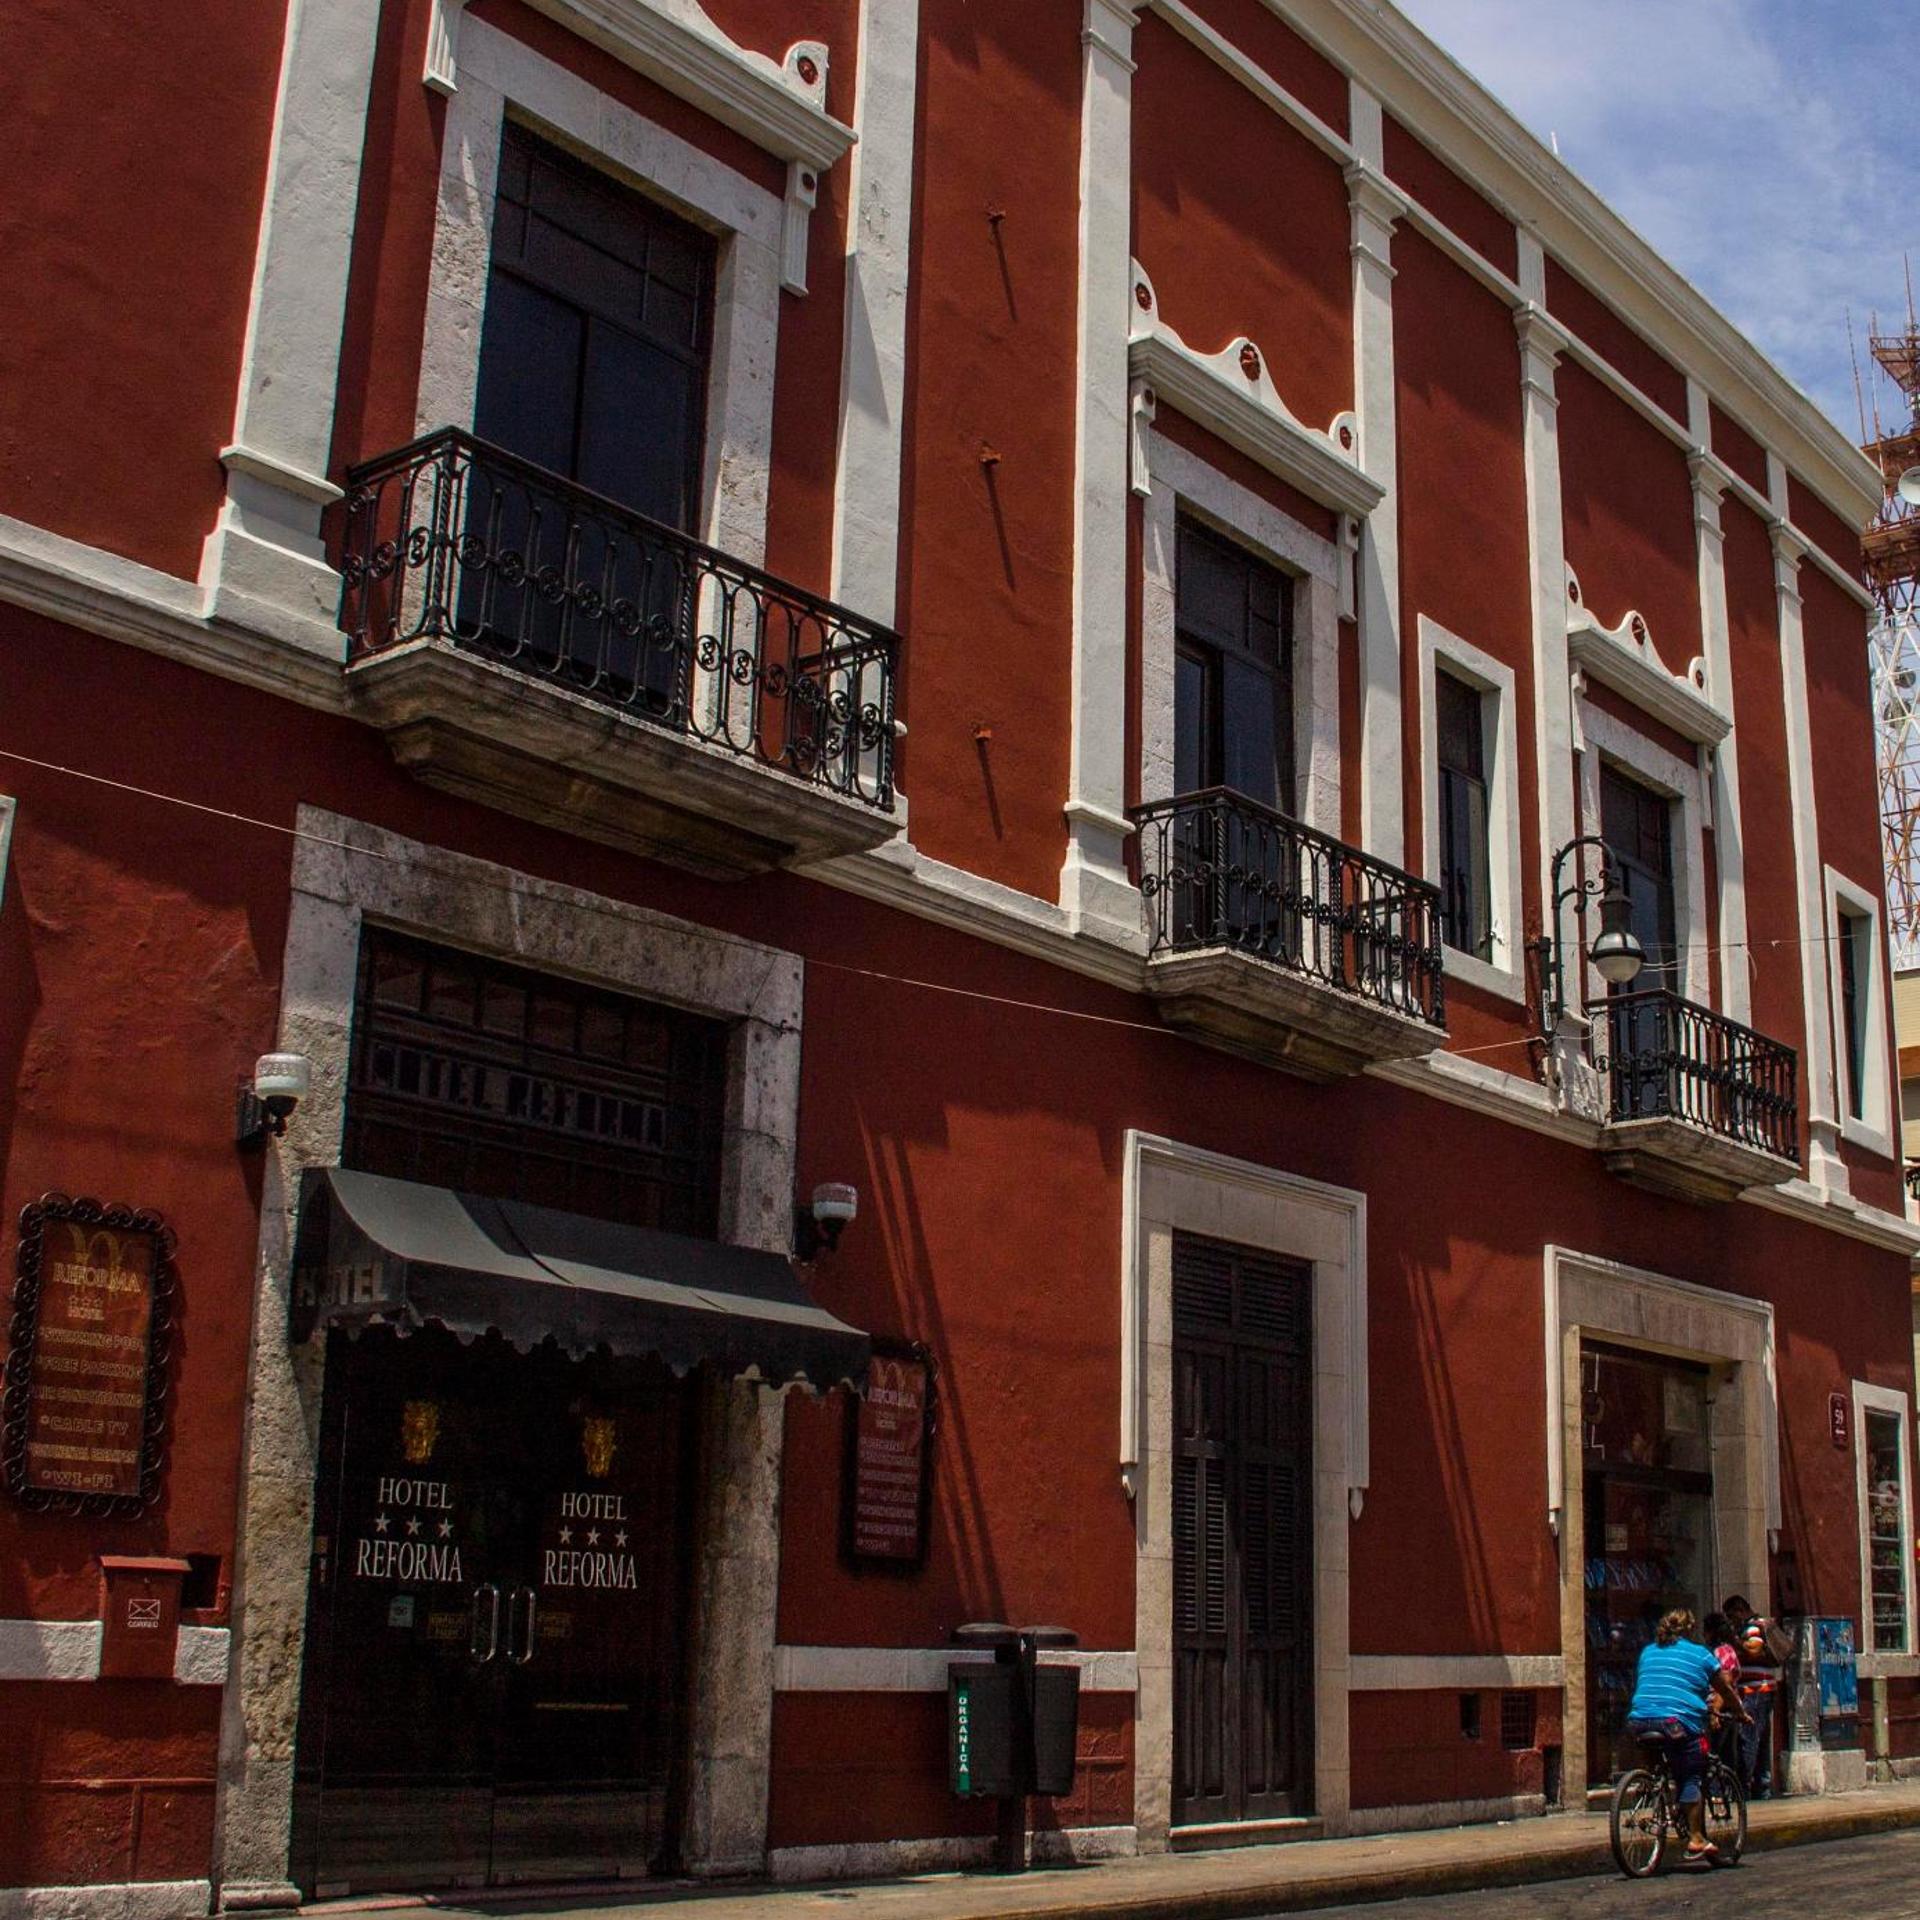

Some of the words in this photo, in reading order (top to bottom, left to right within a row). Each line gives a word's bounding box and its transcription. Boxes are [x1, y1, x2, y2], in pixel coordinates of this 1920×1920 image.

[52, 1262, 142, 1293] REFORMA
[50, 1415, 104, 1434] CABLE
[106, 1419, 129, 1436] TV
[52, 1469, 114, 1489] WI-FI
[377, 1476, 455, 1510] HOTEL
[561, 1492, 628, 1521] HOTEL
[355, 1538, 464, 1583] REFORMA
[544, 1550, 638, 1590] REFORMA
